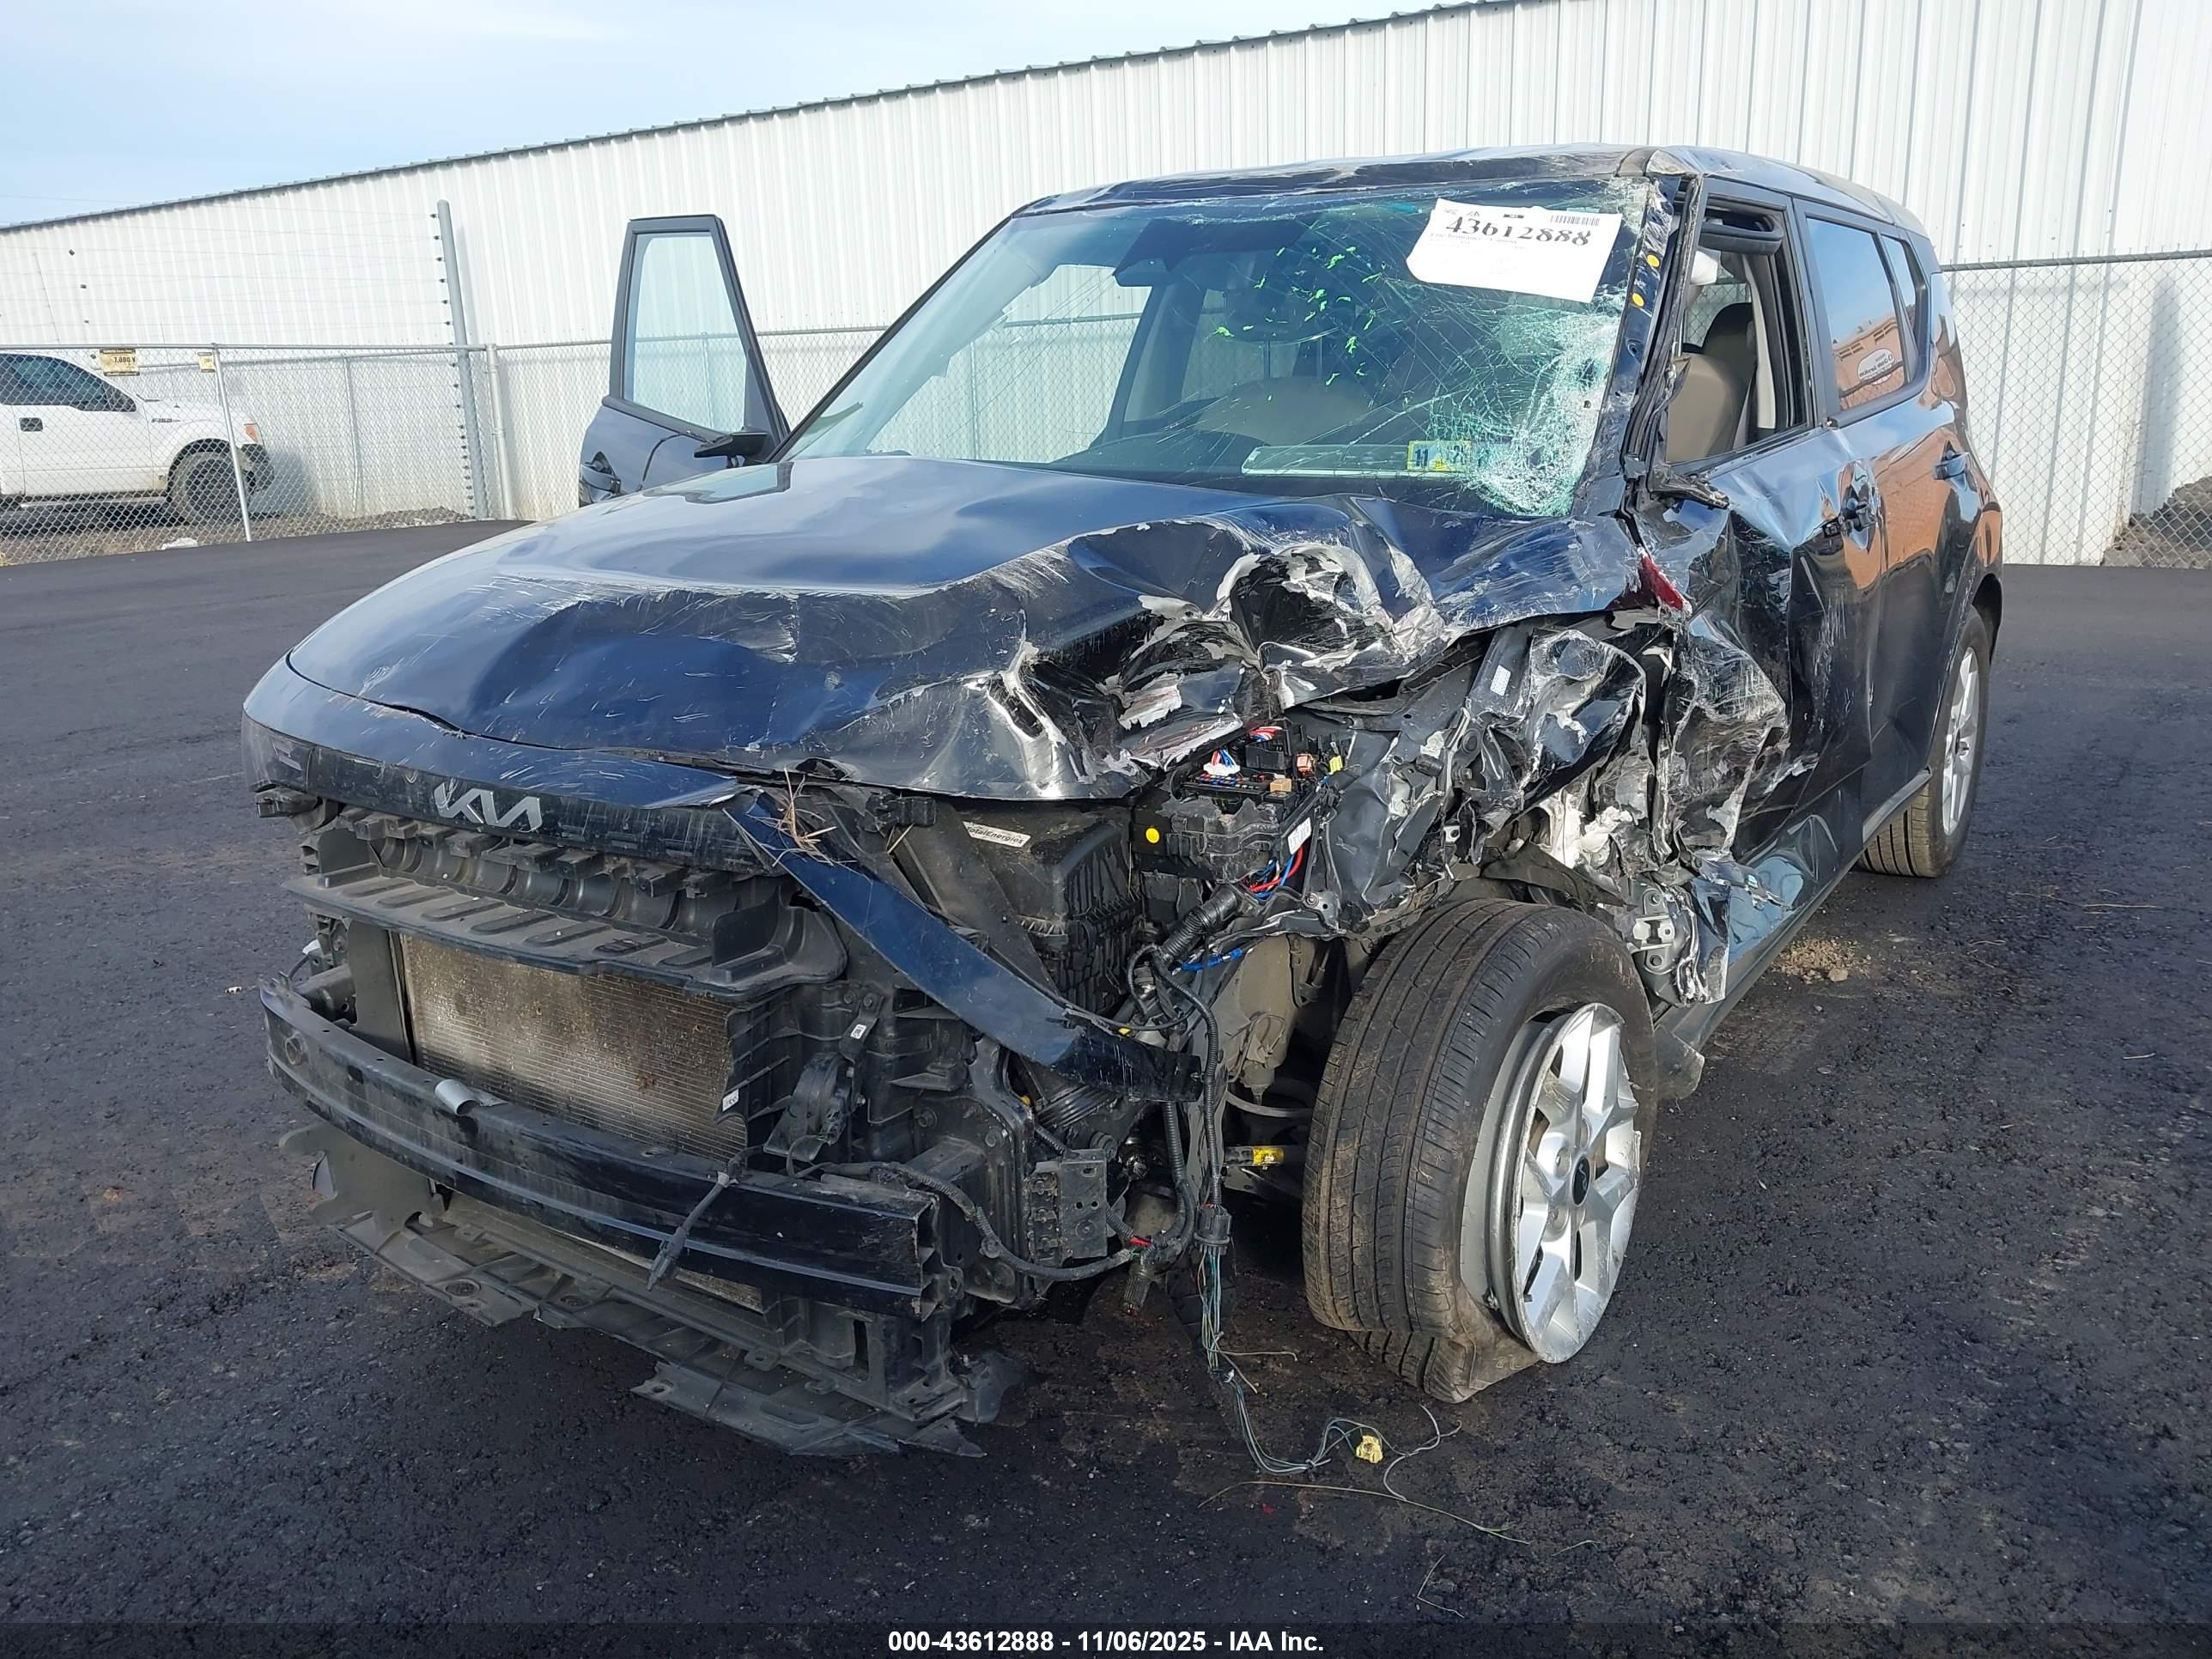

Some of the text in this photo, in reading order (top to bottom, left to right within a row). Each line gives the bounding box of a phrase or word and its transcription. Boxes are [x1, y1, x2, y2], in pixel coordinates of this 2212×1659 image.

[1445, 216, 1592, 246] 43612888
[1414, 448, 1429, 467] 11
[434, 782, 543, 833] KIA
